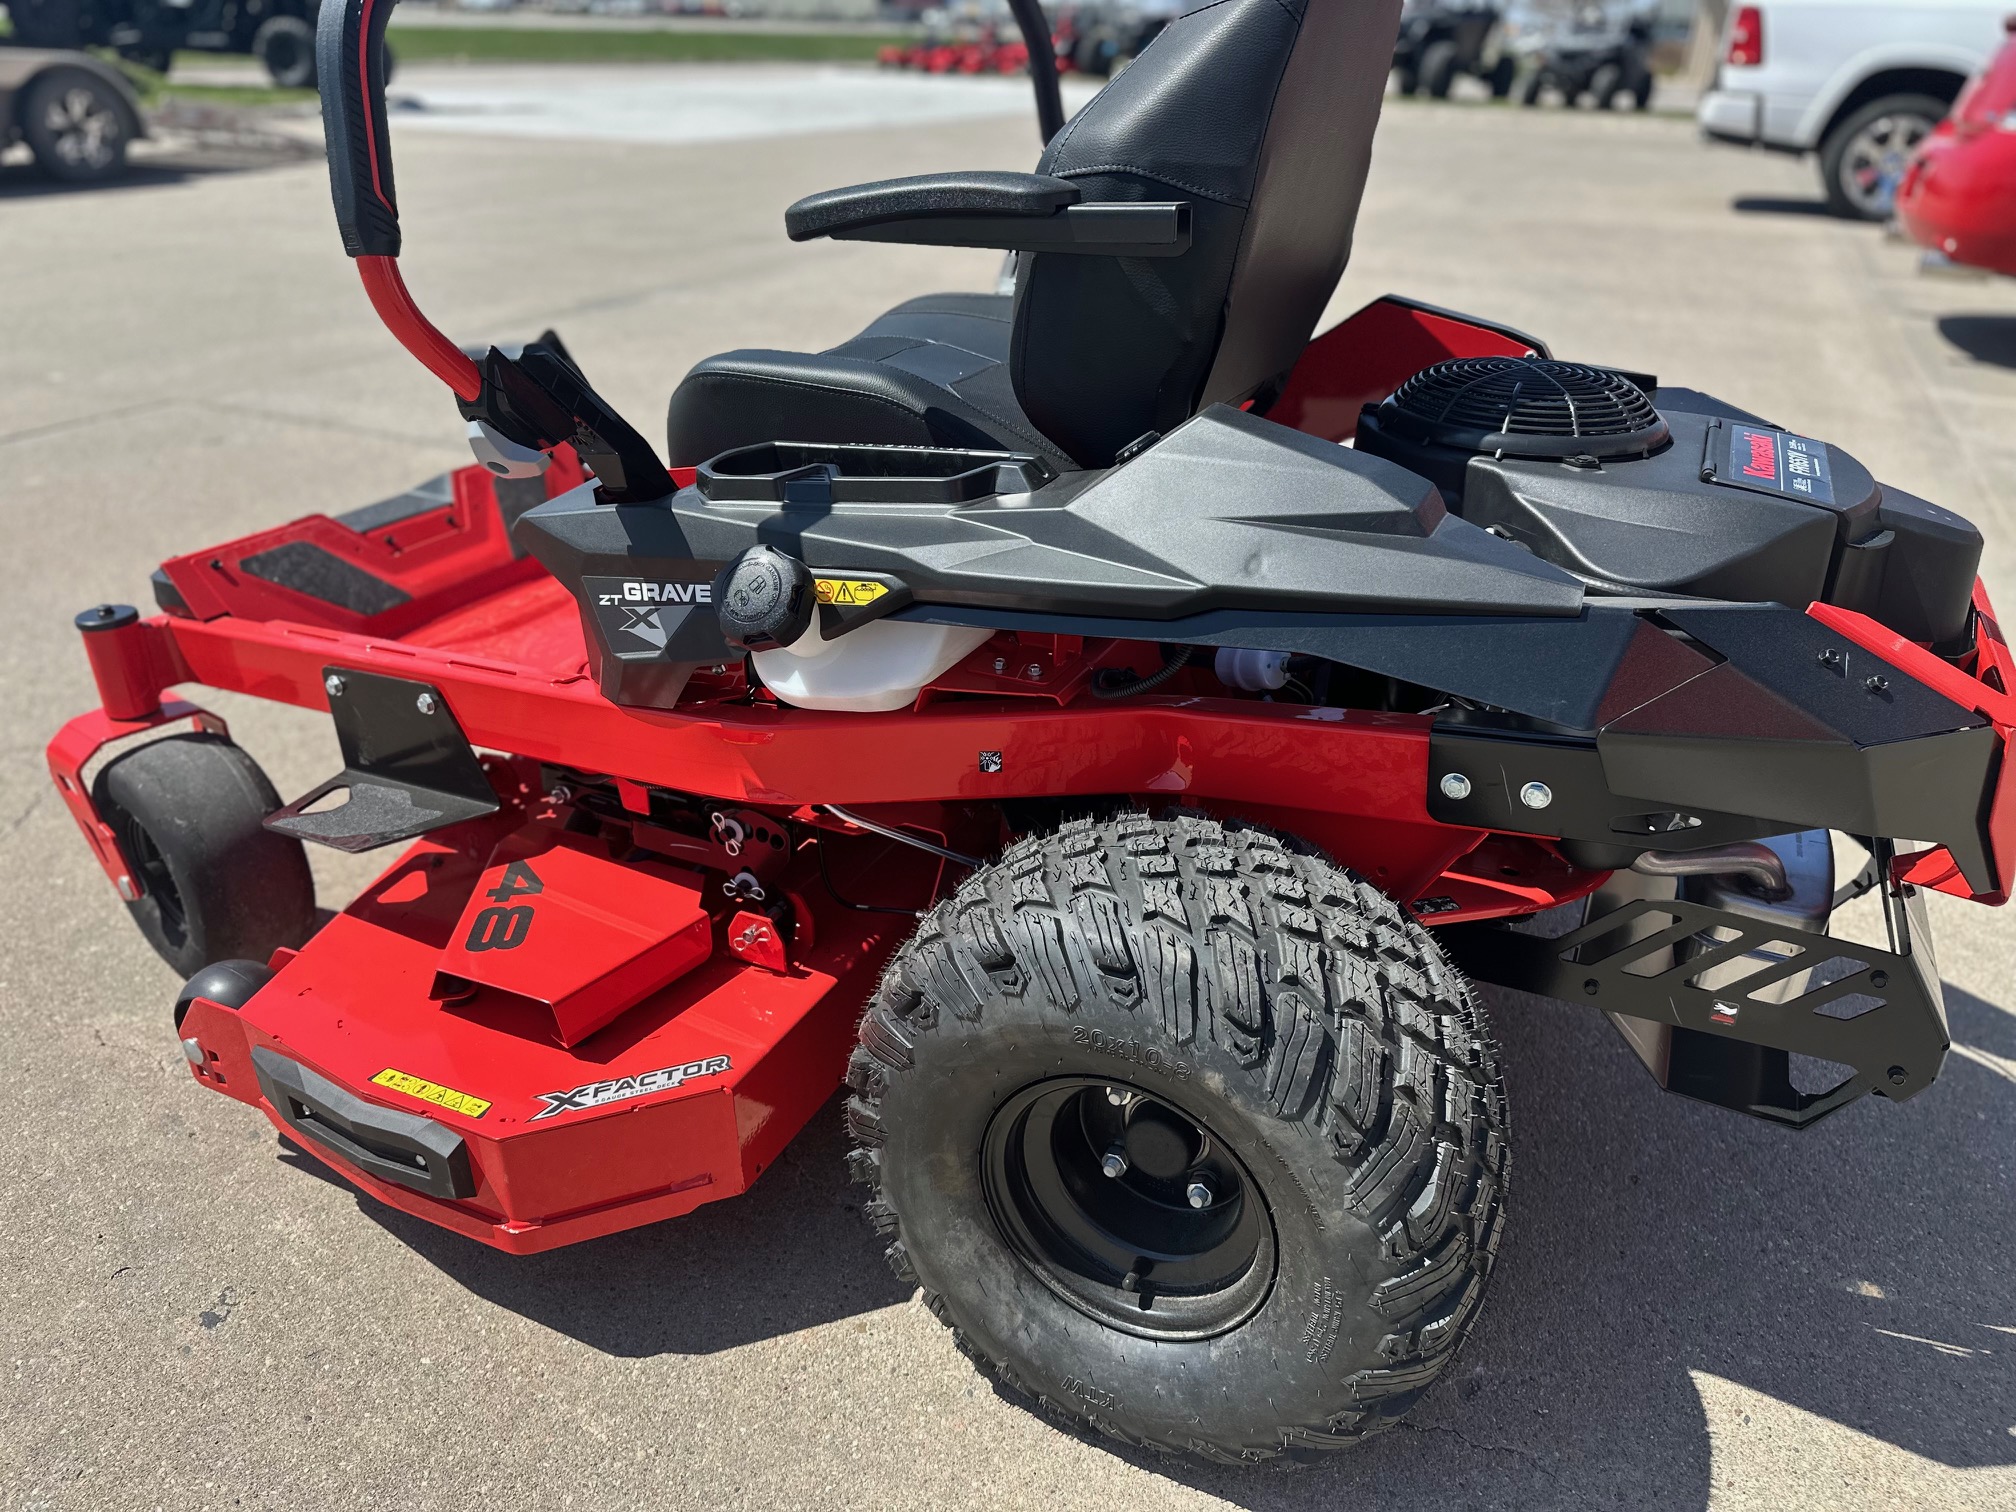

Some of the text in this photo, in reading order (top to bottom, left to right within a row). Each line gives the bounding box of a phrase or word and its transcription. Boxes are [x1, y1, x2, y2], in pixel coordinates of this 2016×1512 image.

[1743, 432, 1775, 480] Kawasaki
[599, 582, 712, 605] ZT GRAVE
[465, 859, 544, 953] 48
[600, 1092, 626, 1102] GAUGE
[629, 1086, 653, 1095] STEEL
[656, 1080, 676, 1088] DECK
[1061, 1375, 1116, 1411] KTW
